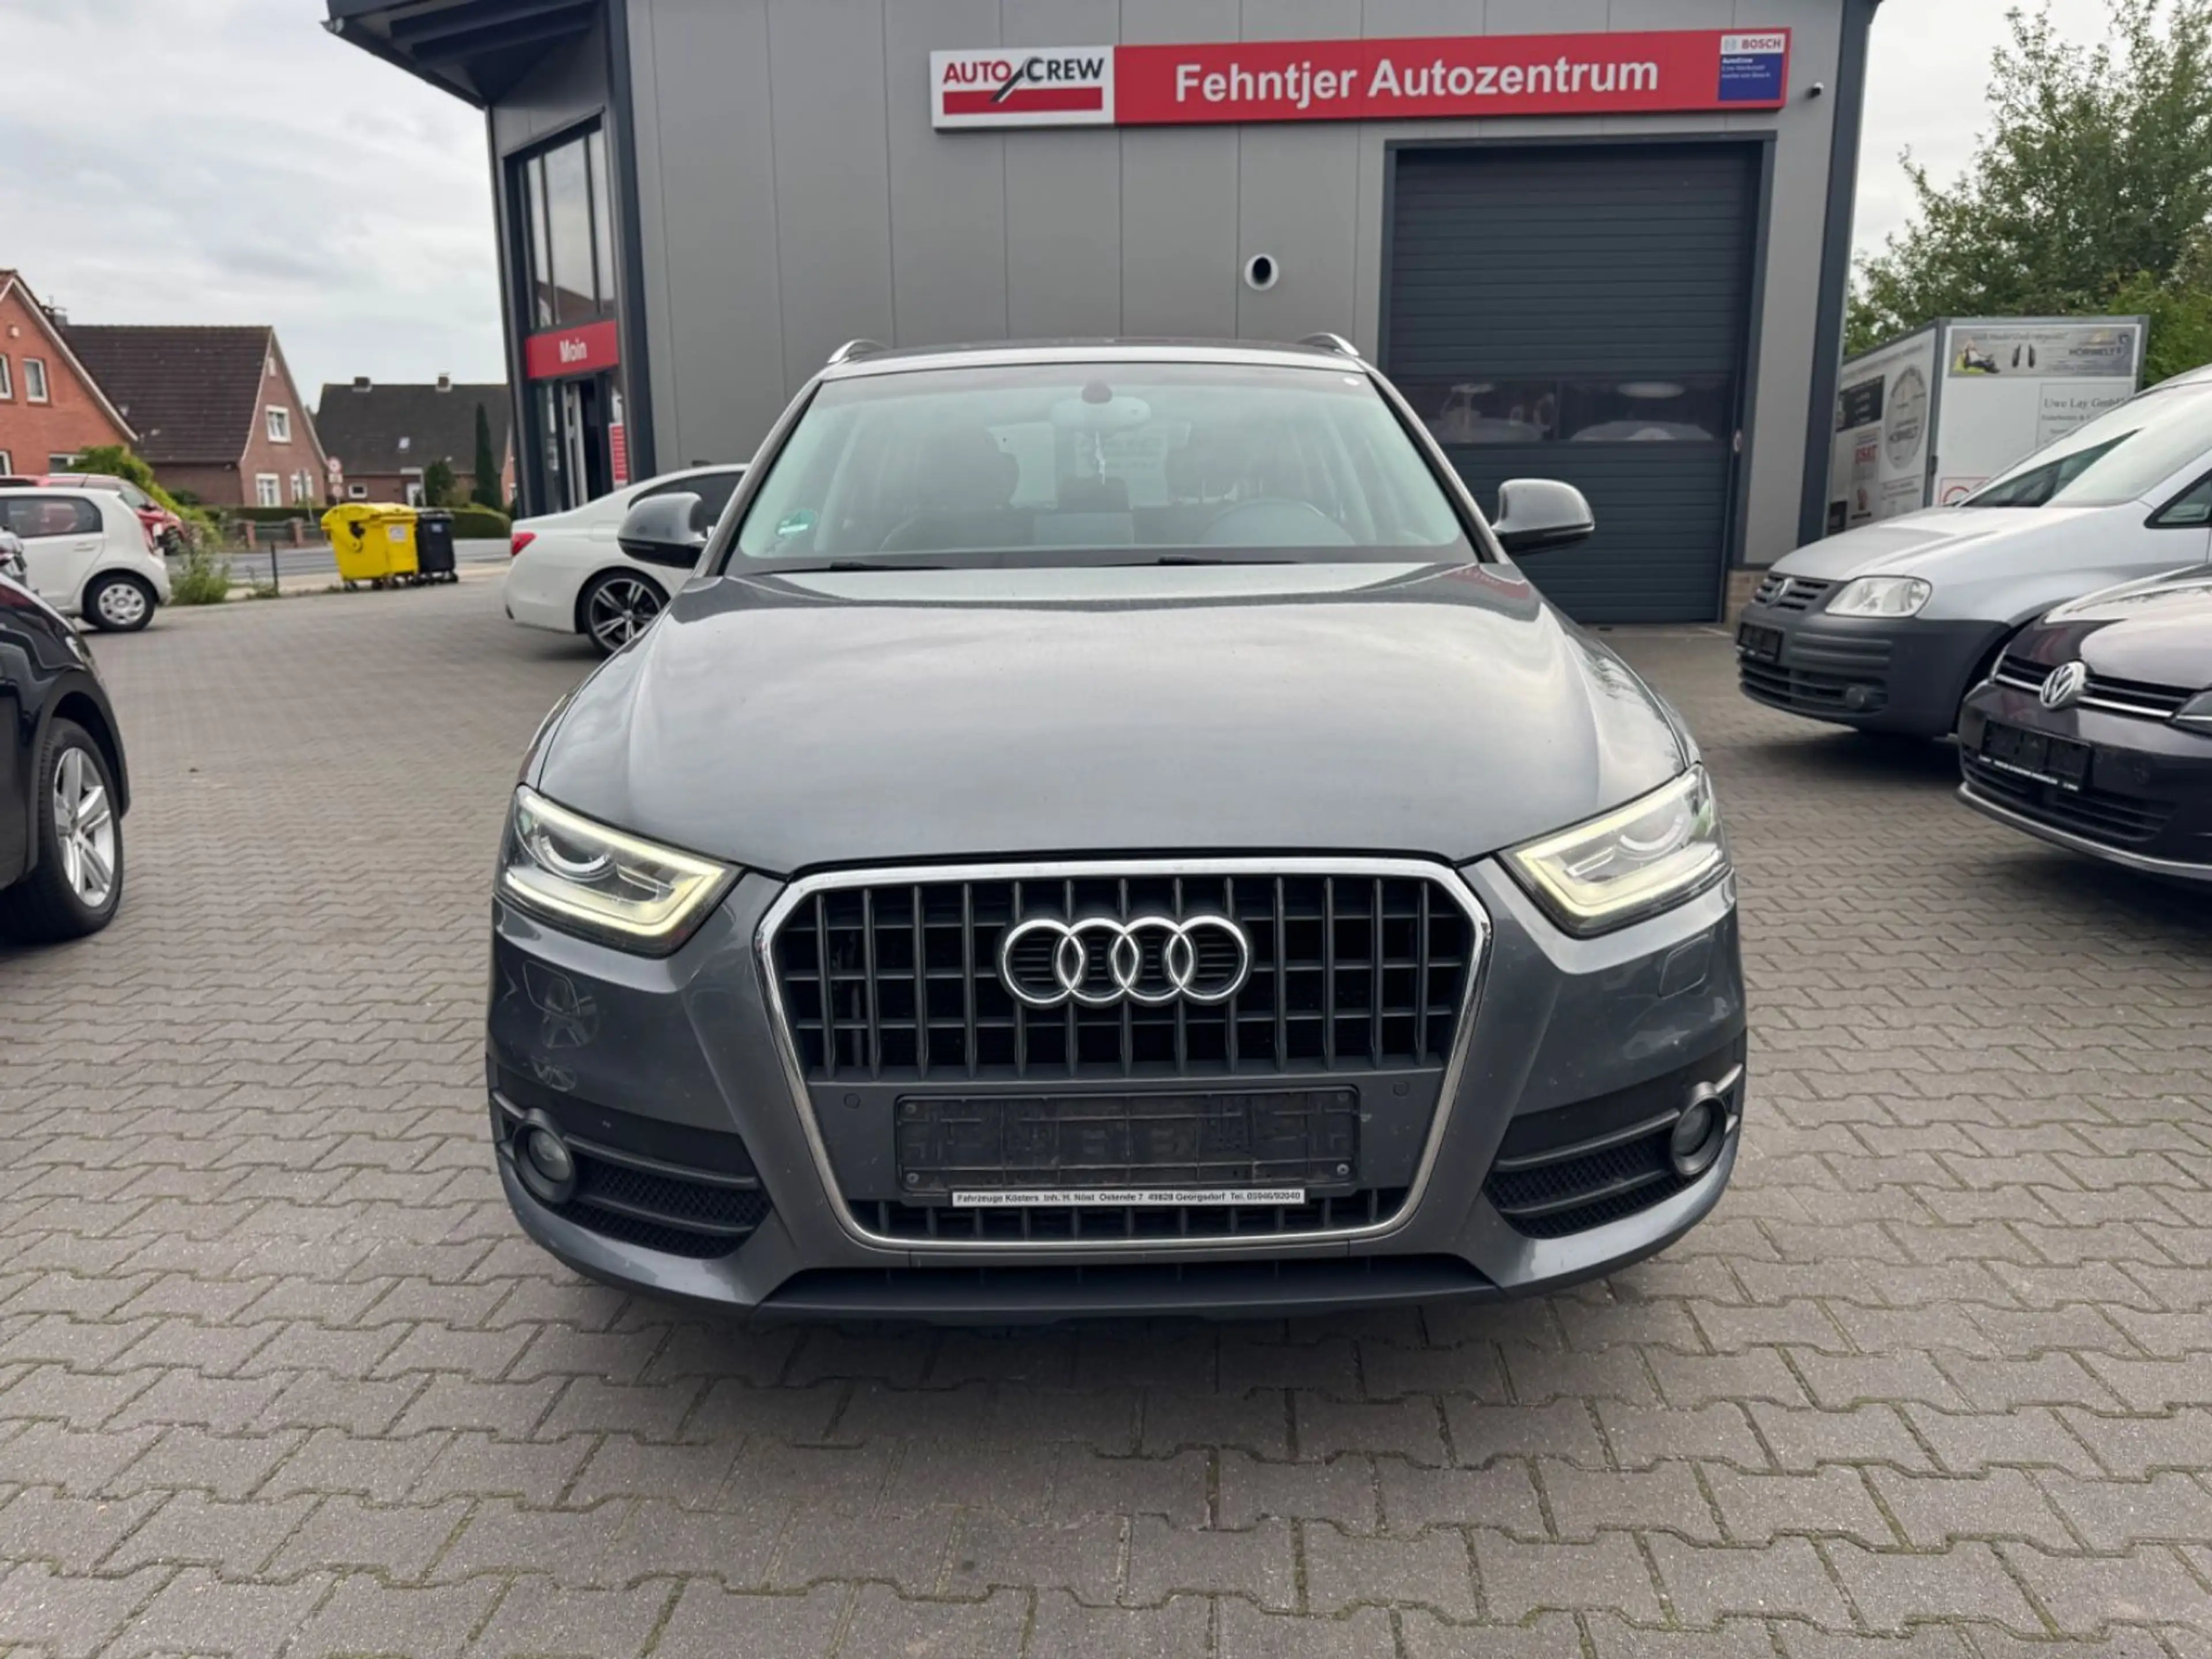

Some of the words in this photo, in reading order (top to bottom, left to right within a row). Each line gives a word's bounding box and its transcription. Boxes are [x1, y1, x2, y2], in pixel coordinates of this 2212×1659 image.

[1741, 38, 1782, 50] BOSCH
[942, 60, 1012, 84] AUTO
[1025, 56, 1105, 82] CREW
[1176, 62, 1357, 109] Fehntjer
[1368, 56, 1658, 97] Autozentrum
